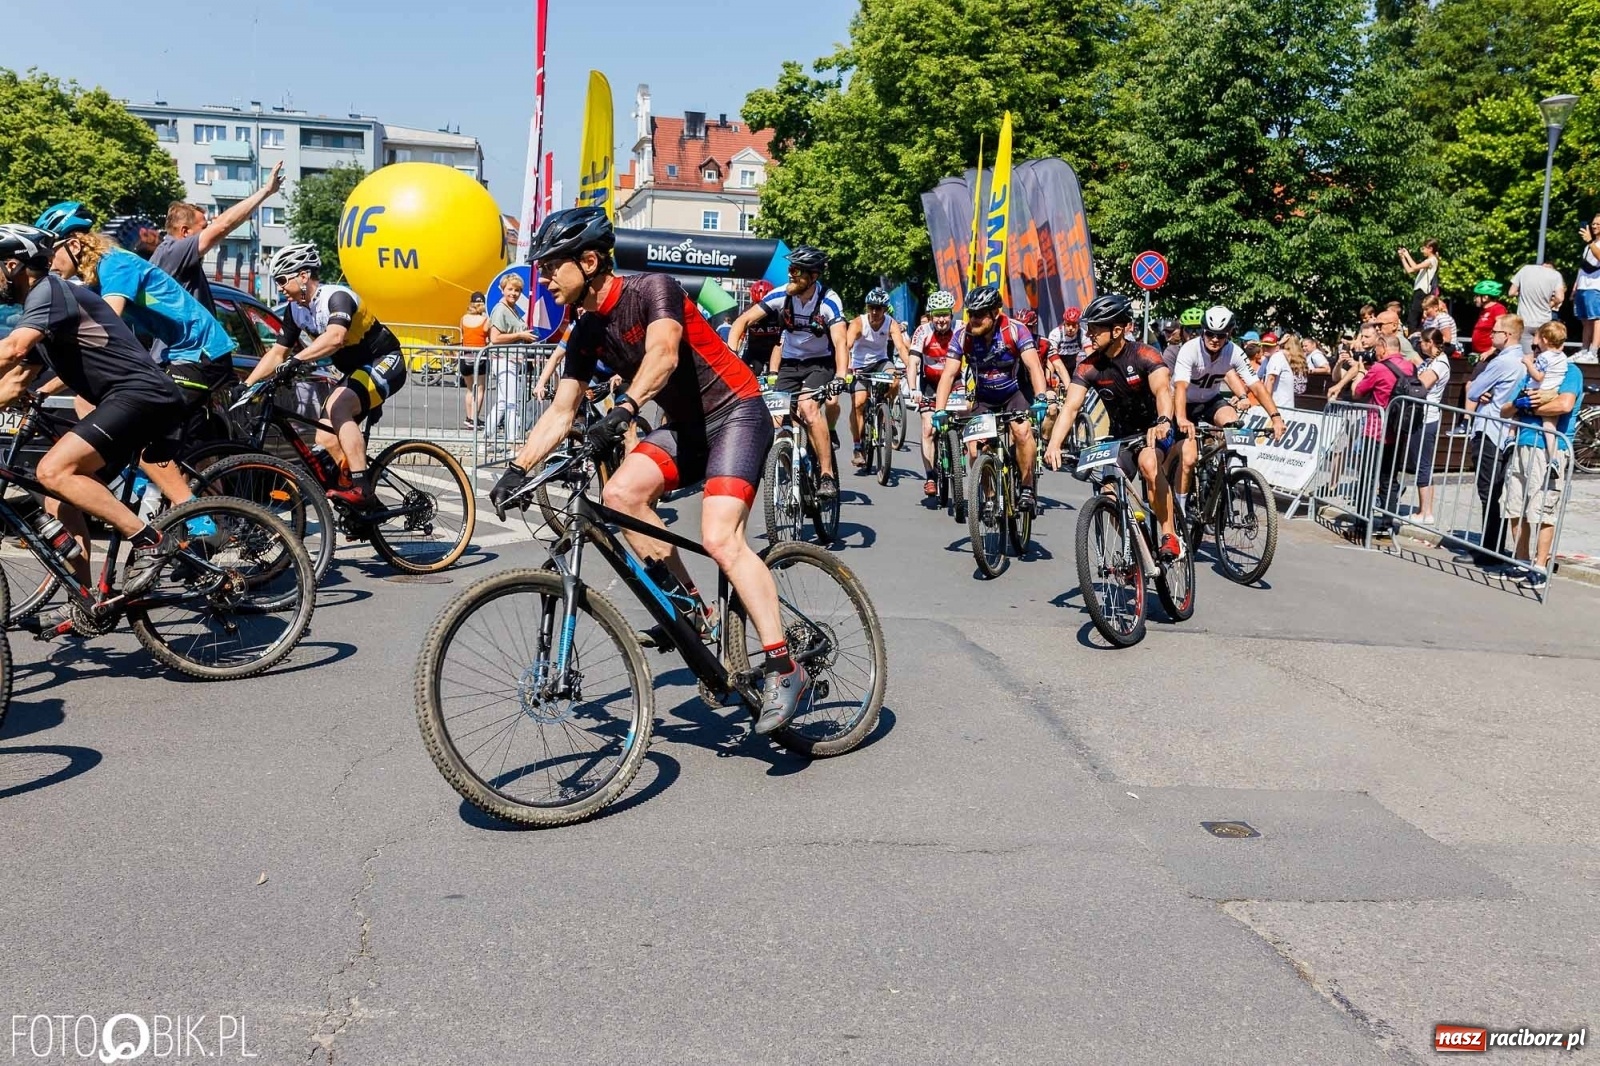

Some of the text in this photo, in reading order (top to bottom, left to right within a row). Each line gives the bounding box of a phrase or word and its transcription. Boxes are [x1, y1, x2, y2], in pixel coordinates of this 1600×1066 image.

[378, 247, 419, 269] FM
[647, 244, 737, 266] bike atelier
[1086, 450, 1111, 462] 1756
